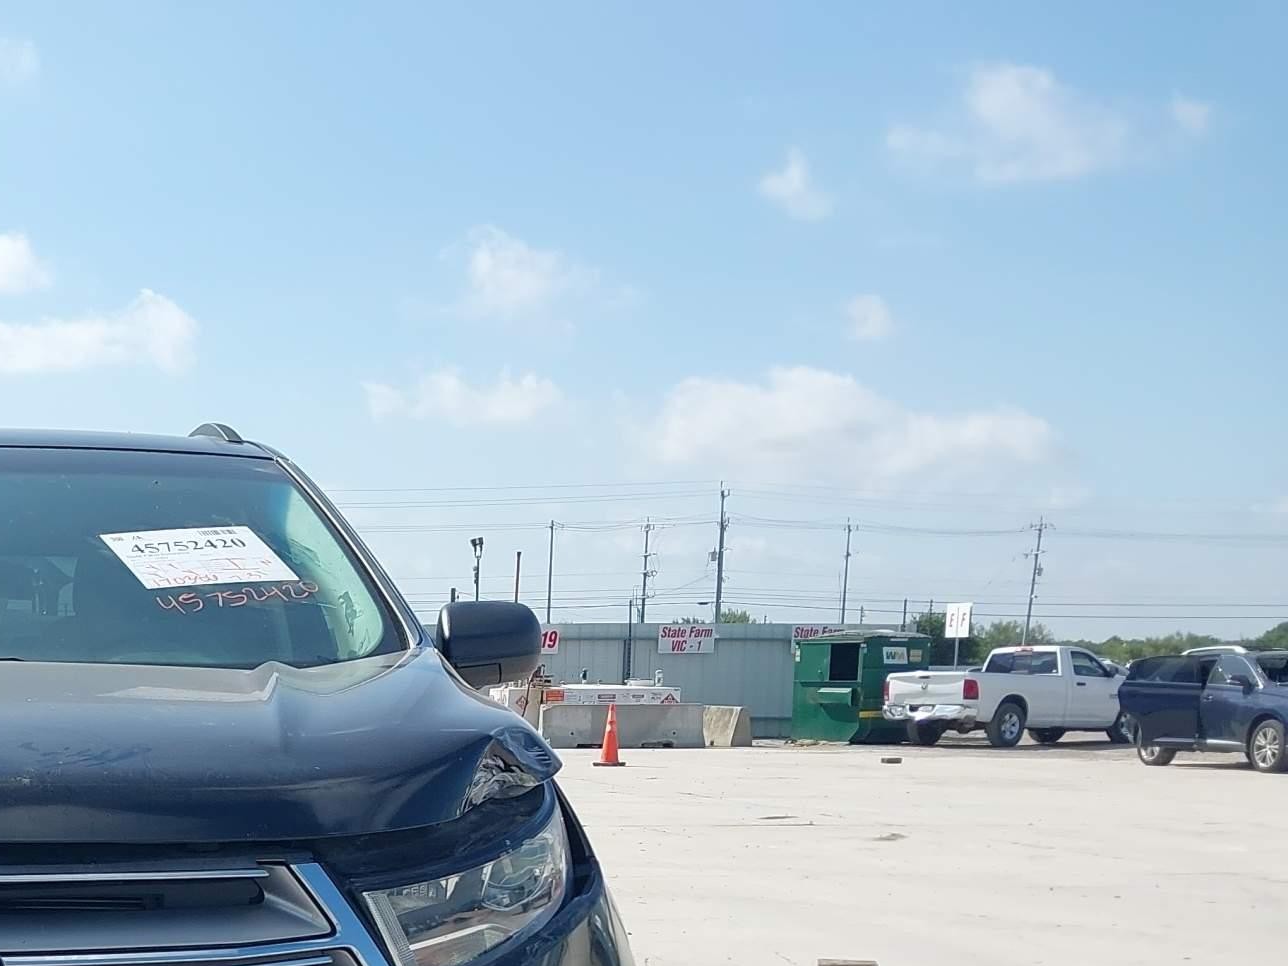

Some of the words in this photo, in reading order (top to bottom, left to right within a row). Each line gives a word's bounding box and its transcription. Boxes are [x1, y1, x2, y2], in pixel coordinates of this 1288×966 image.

[131, 537, 247, 555] 45752420
[155, 580, 320, 615] 45752420
[541, 630, 558, 649] 19
[661, 626, 686, 638] State
[688, 626, 713, 638] Farm
[794, 626, 819, 639] State
[671, 640, 687, 652] VIC
[697, 640, 702, 651] 1
